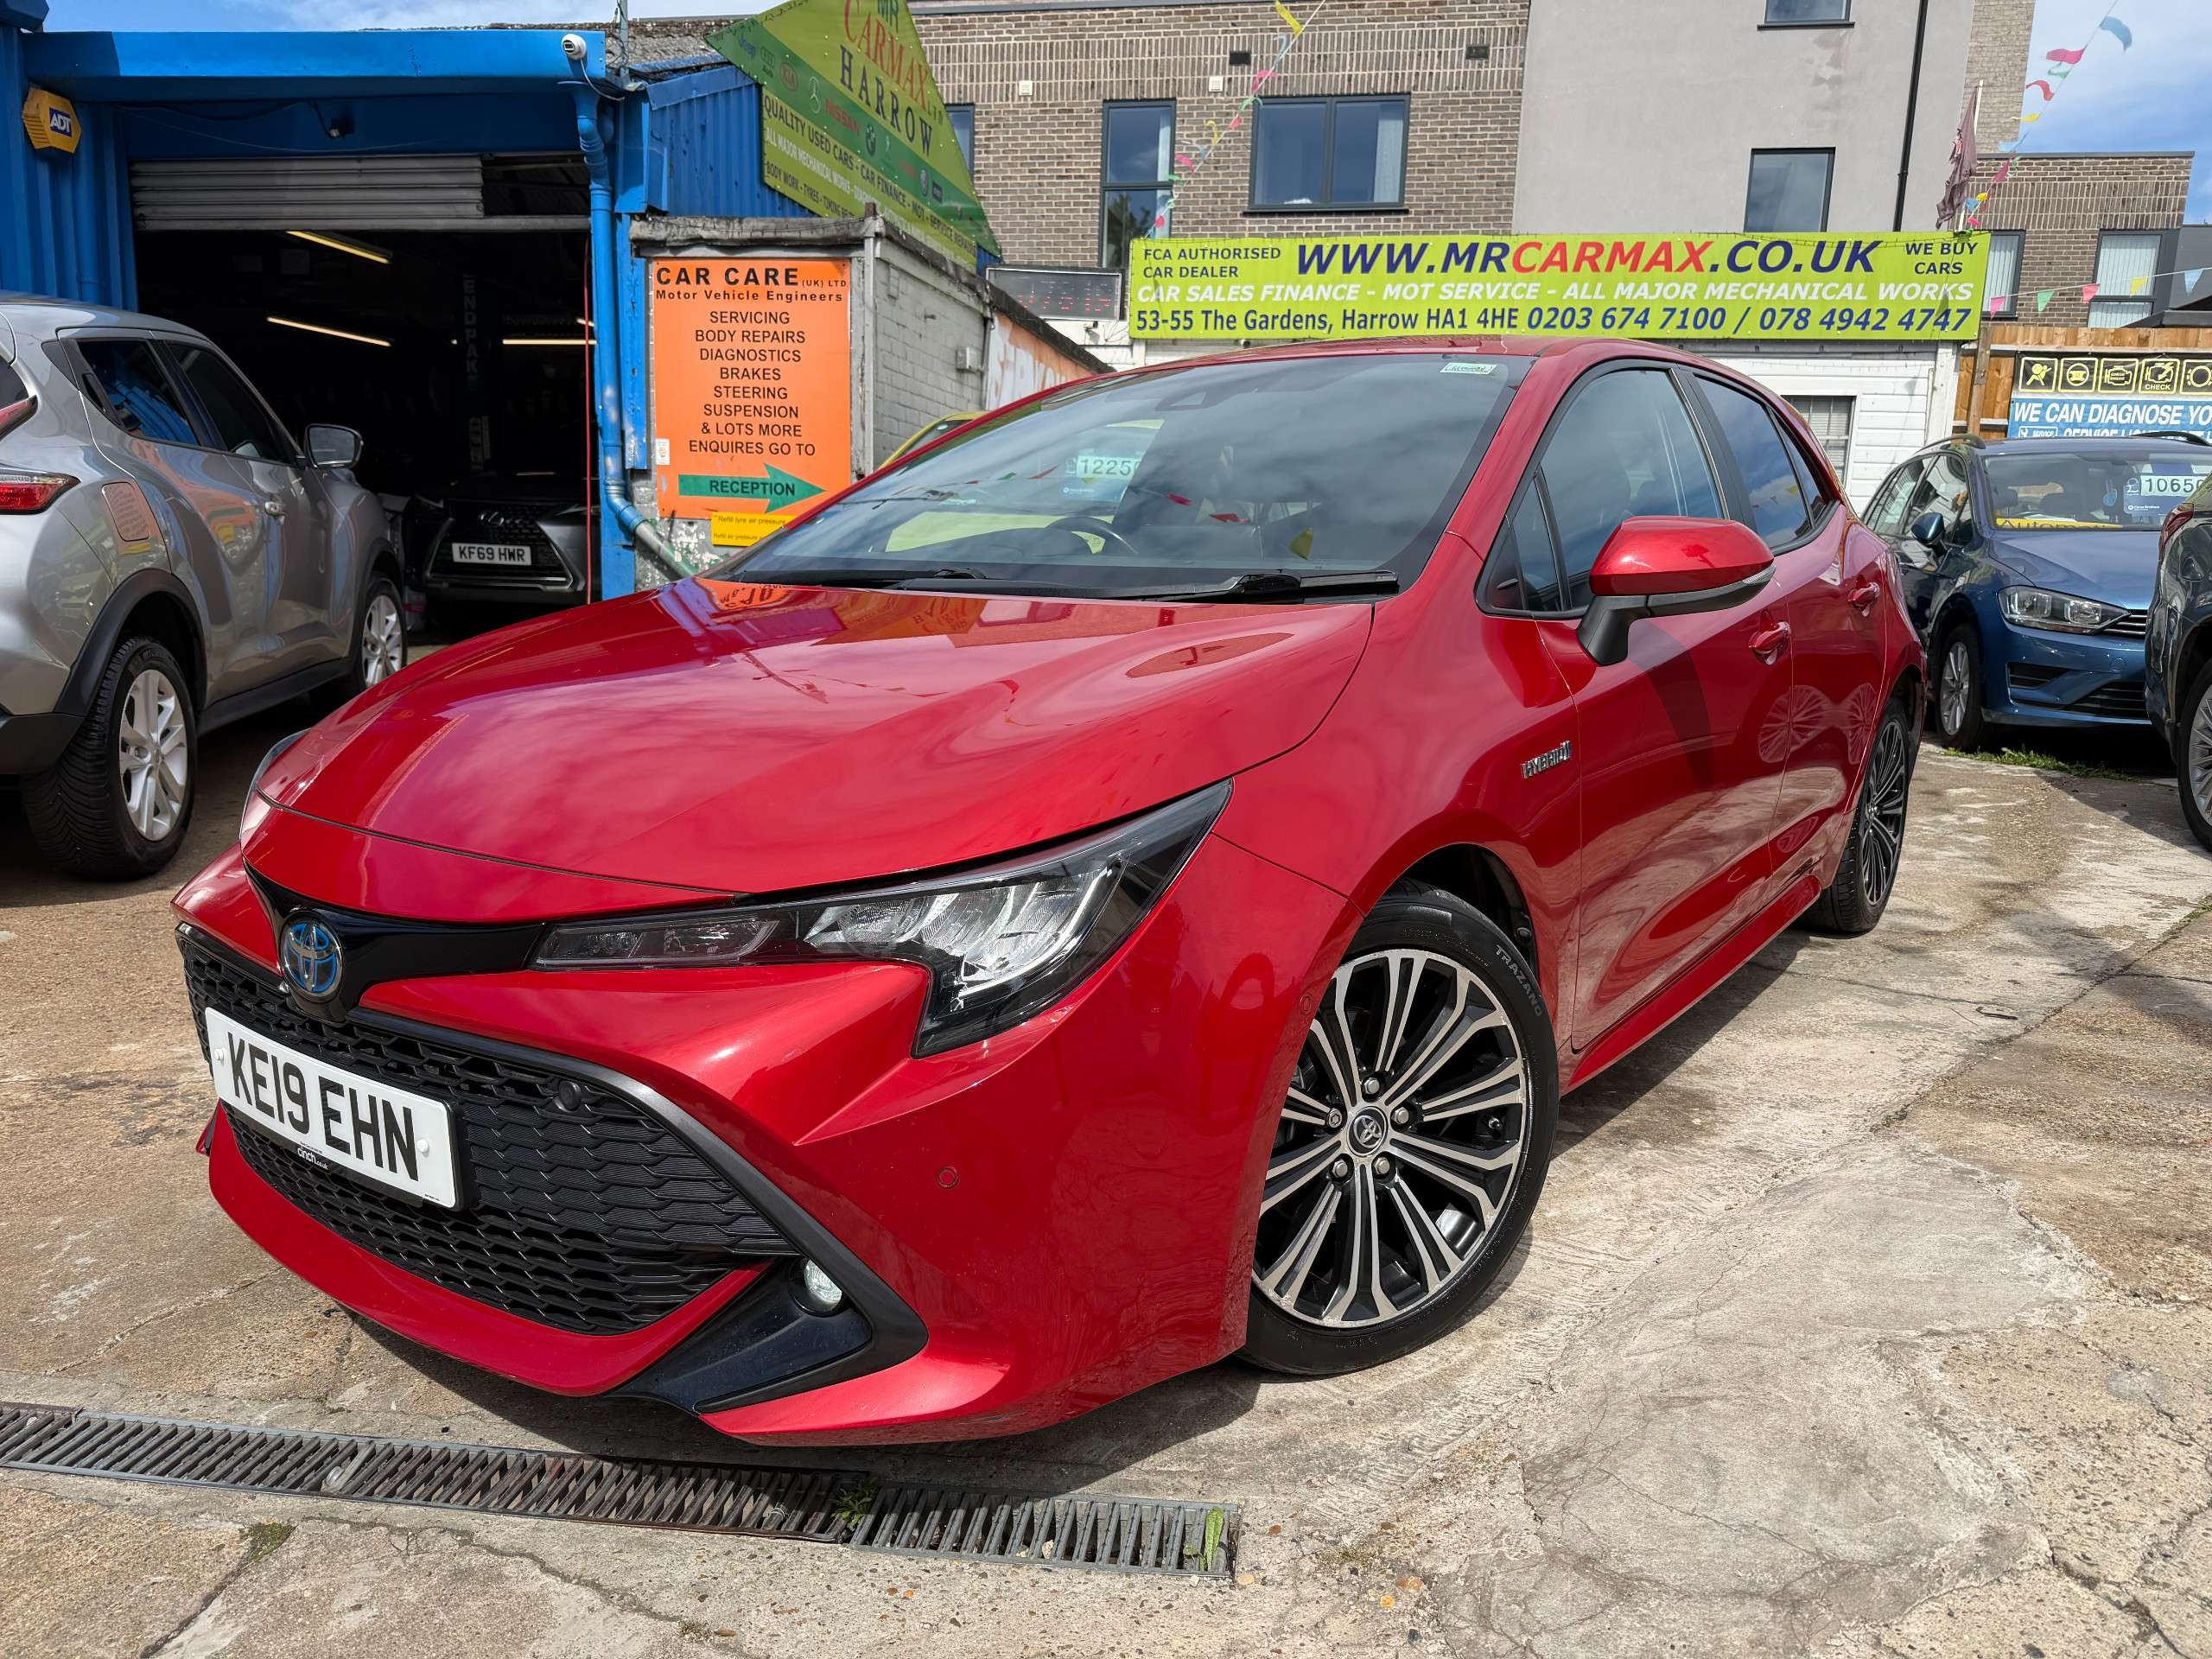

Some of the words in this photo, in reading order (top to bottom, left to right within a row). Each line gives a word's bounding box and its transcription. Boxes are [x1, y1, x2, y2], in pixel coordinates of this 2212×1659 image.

[844, 0, 929, 111] CARMAX
[840, 44, 933, 157] HARROW
[50, 113, 72, 133] ADT
[764, 95, 805, 137] QUALITY
[809, 125, 830, 154] USED
[833, 144, 854, 171] CARS
[861, 164, 876, 188] CAR
[877, 175, 906, 208] FINANCE
[1143, 248, 1173, 260] FCA
[1179, 246, 1281, 260] AUTHORISED
[1904, 243, 1934, 255] WE
[1940, 242, 1978, 255] BUY
[1297, 240, 1884, 275] WWW.MRCARMAX.CO.UK
[1143, 266, 1173, 278] CAR
[1179, 265, 1238, 278] DEALER
[1914, 262, 1963, 275] CARS
[656, 267, 711, 285] CAR
[724, 267, 800, 286] CARE
[802, 279, 824, 288] (UK)
[829, 279, 848, 288] LTD
[656, 289, 698, 300] Motor
[704, 289, 760, 301] Vehicle
[766, 290, 843, 303] Engineers
[1137, 285, 1180, 302] CAR
[1185, 285, 1254, 302] SALES
[1260, 283, 1361, 302] FINANCE
[1382, 283, 1433, 301] MOT
[1439, 283, 1541, 301] SERVICE
[1562, 283, 1605, 300] ALL
[1612, 283, 1698, 301] MAJOR
[1703, 283, 1868, 301] MECHANICAL
[1878, 283, 1975, 301] WORKS
[463, 269, 480, 373] ENDPAK
[709, 311, 790, 325] SERVICING
[1136, 309, 1194, 331] 53-55
[1201, 308, 1237, 331] The
[1244, 308, 1335, 334] Gardens,
[1342, 308, 1420, 330] Harrow
[1427, 308, 1469, 330] HA1
[1477, 308, 1519, 330] 4HE
[1528, 307, 1592, 331] 0203
[1601, 307, 1650, 330] 674
[1659, 307, 1726, 331] 7100
[1759, 307, 1813, 332] 078
[1819, 308, 1890, 333] 4942
[1897, 308, 1973, 333] 4747
[695, 329, 735, 343] BODY
[741, 330, 805, 344] REPAIRS
[699, 348, 802, 362] DIAGNOSTICS
[720, 367, 781, 380] BRAKES
[713, 385, 788, 399] STEERING
[703, 404, 799, 418] SUSPENSION
[2014, 402, 2043, 423] WE
[2045, 403, 2085, 423] CAN
[2088, 404, 2184, 425] DIAGNOSE
[701, 423, 711, 435] &
[716, 423, 753, 435] LOTS
[759, 423, 802, 436] MORE
[689, 441, 764, 454] ENQUIRES
[769, 442, 791, 455] GO
[797, 443, 816, 456] TO
[709, 480, 796, 496] RECEPTION
[459, 546, 495, 560] KF69
[499, 548, 525, 562] HWR
[1521, 741, 1570, 779] HYBRID
[1495, 944, 1542, 1016] TRAZANO
[227, 1032, 311, 1135] KE19
[318, 1076, 419, 1182] EHN
